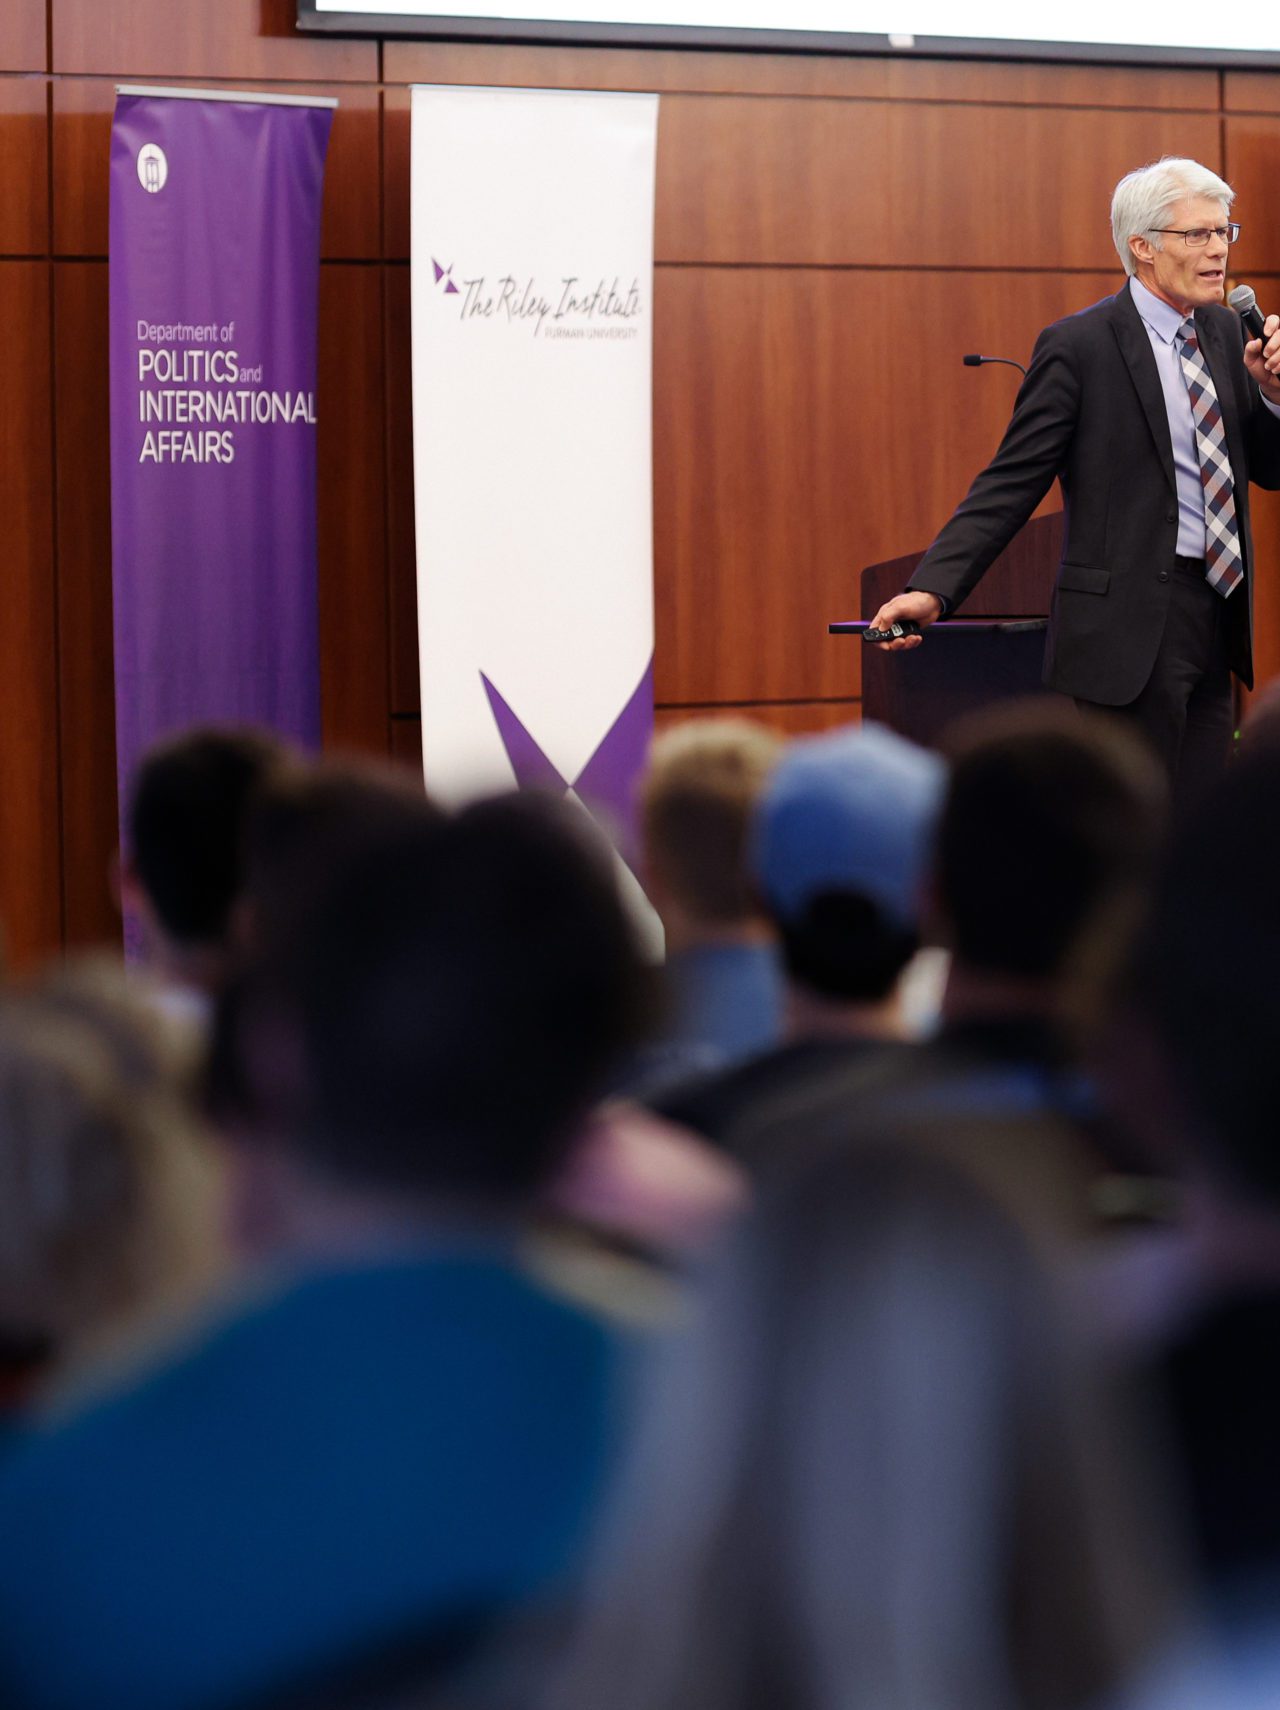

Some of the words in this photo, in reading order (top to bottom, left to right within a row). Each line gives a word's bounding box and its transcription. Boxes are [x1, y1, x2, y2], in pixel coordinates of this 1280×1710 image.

[460, 276, 493, 320] The
[497, 274, 550, 337] Riley
[553, 276, 639, 320] Institute
[137, 320, 218, 344] Department
[220, 321, 235, 342] of
[138, 349, 239, 383] POLITICS
[239, 364, 263, 383] and
[139, 389, 318, 424] INTERNATIONAL
[139, 430, 235, 463] AFFAIRS
